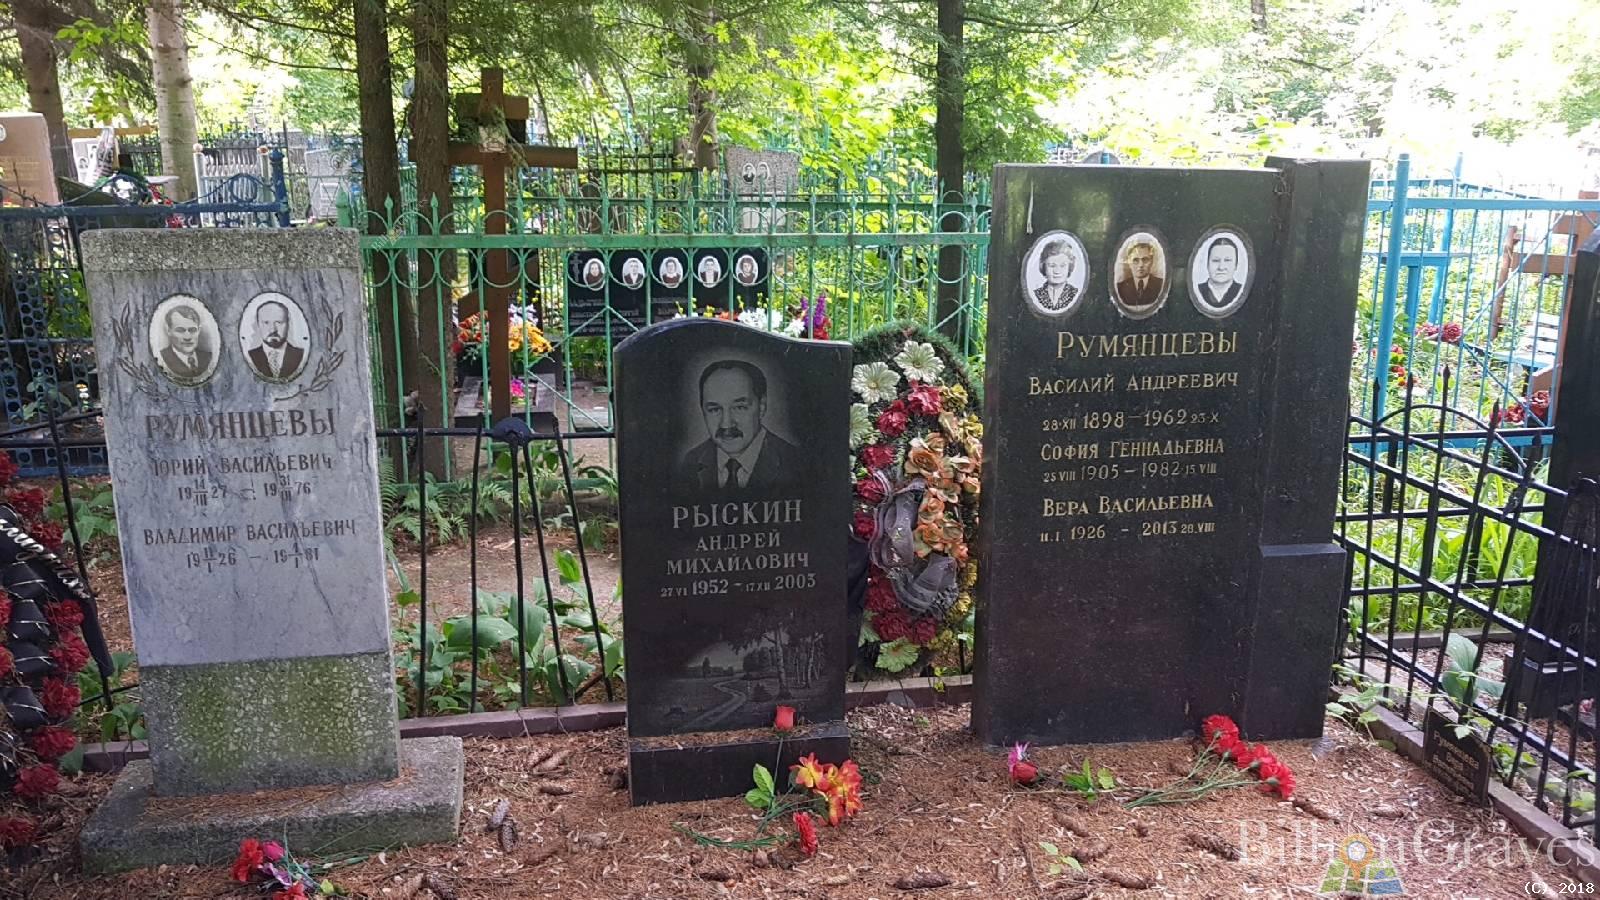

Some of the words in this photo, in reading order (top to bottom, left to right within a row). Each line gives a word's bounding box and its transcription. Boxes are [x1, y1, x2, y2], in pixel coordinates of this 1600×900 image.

[1056, 331, 1238, 359] РУМЯНЦЕВЫ
[145, 408, 336, 442] РУМЯНЦЕВЫ
[1083, 411, 1125, 429] 1898
[1143, 409, 1187, 426] 1962
[1041, 443, 1099, 461] СОФИЯ
[1109, 438, 1225, 458] ГЕННАДЬЕВНА
[152, 455, 206, 476] ЮРИЙ
[219, 453, 332, 474] ВАСИЛЬЕВИЧ
[1082, 464, 1119, 481] 1905
[1142, 462, 1180, 478] 1982
[672, 499, 803, 528] РЫСКИН
[1043, 498, 1089, 517] ВЕРА
[1099, 494, 1214, 514] ВАСИЛЬЕВНА
[144, 525, 238, 545] ВЛАДИМИР
[247, 519, 356, 541] ВАСИЛЬЕВИЧ
[696, 529, 781, 551] АНДРЕЙ
[1071, 524, 1106, 540] 1926
[1142, 521, 1178, 536] 2013
[667, 552, 809, 575] МИХАЙЛОВИЧ
[692, 579, 729, 596] 1952
[774, 573, 817, 590] 2003
